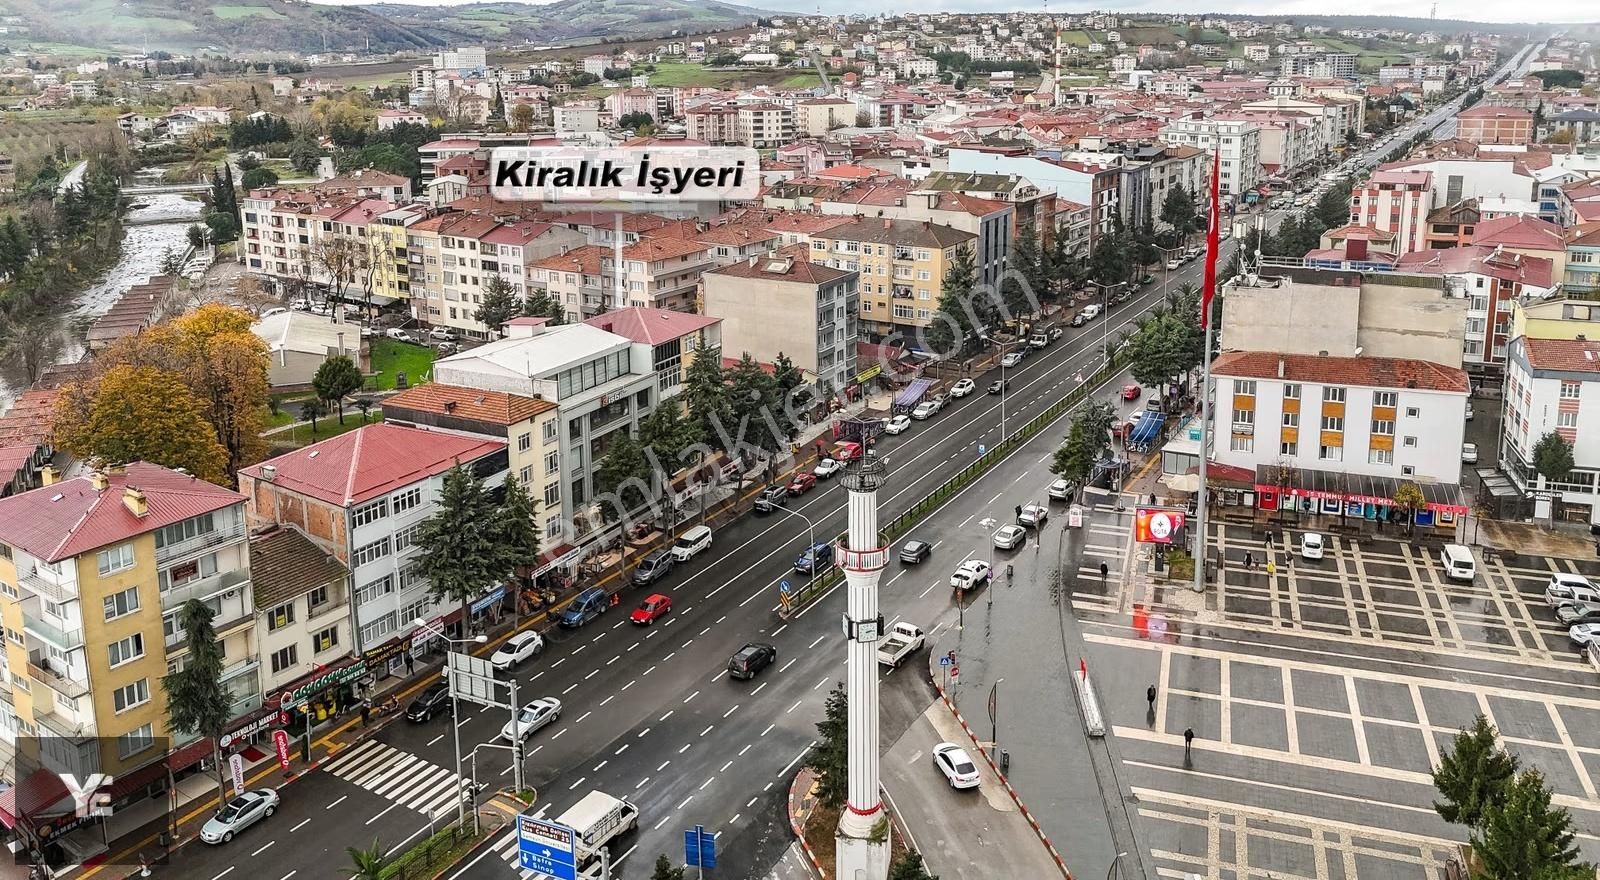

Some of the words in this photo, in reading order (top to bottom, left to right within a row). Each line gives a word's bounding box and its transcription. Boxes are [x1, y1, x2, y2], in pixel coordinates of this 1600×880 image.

[258, 711, 279, 725] MARKET
[49, 821, 77, 838] EKMEK
[532, 855, 552, 866] Bafra
[532, 862, 554, 875] Sinop
